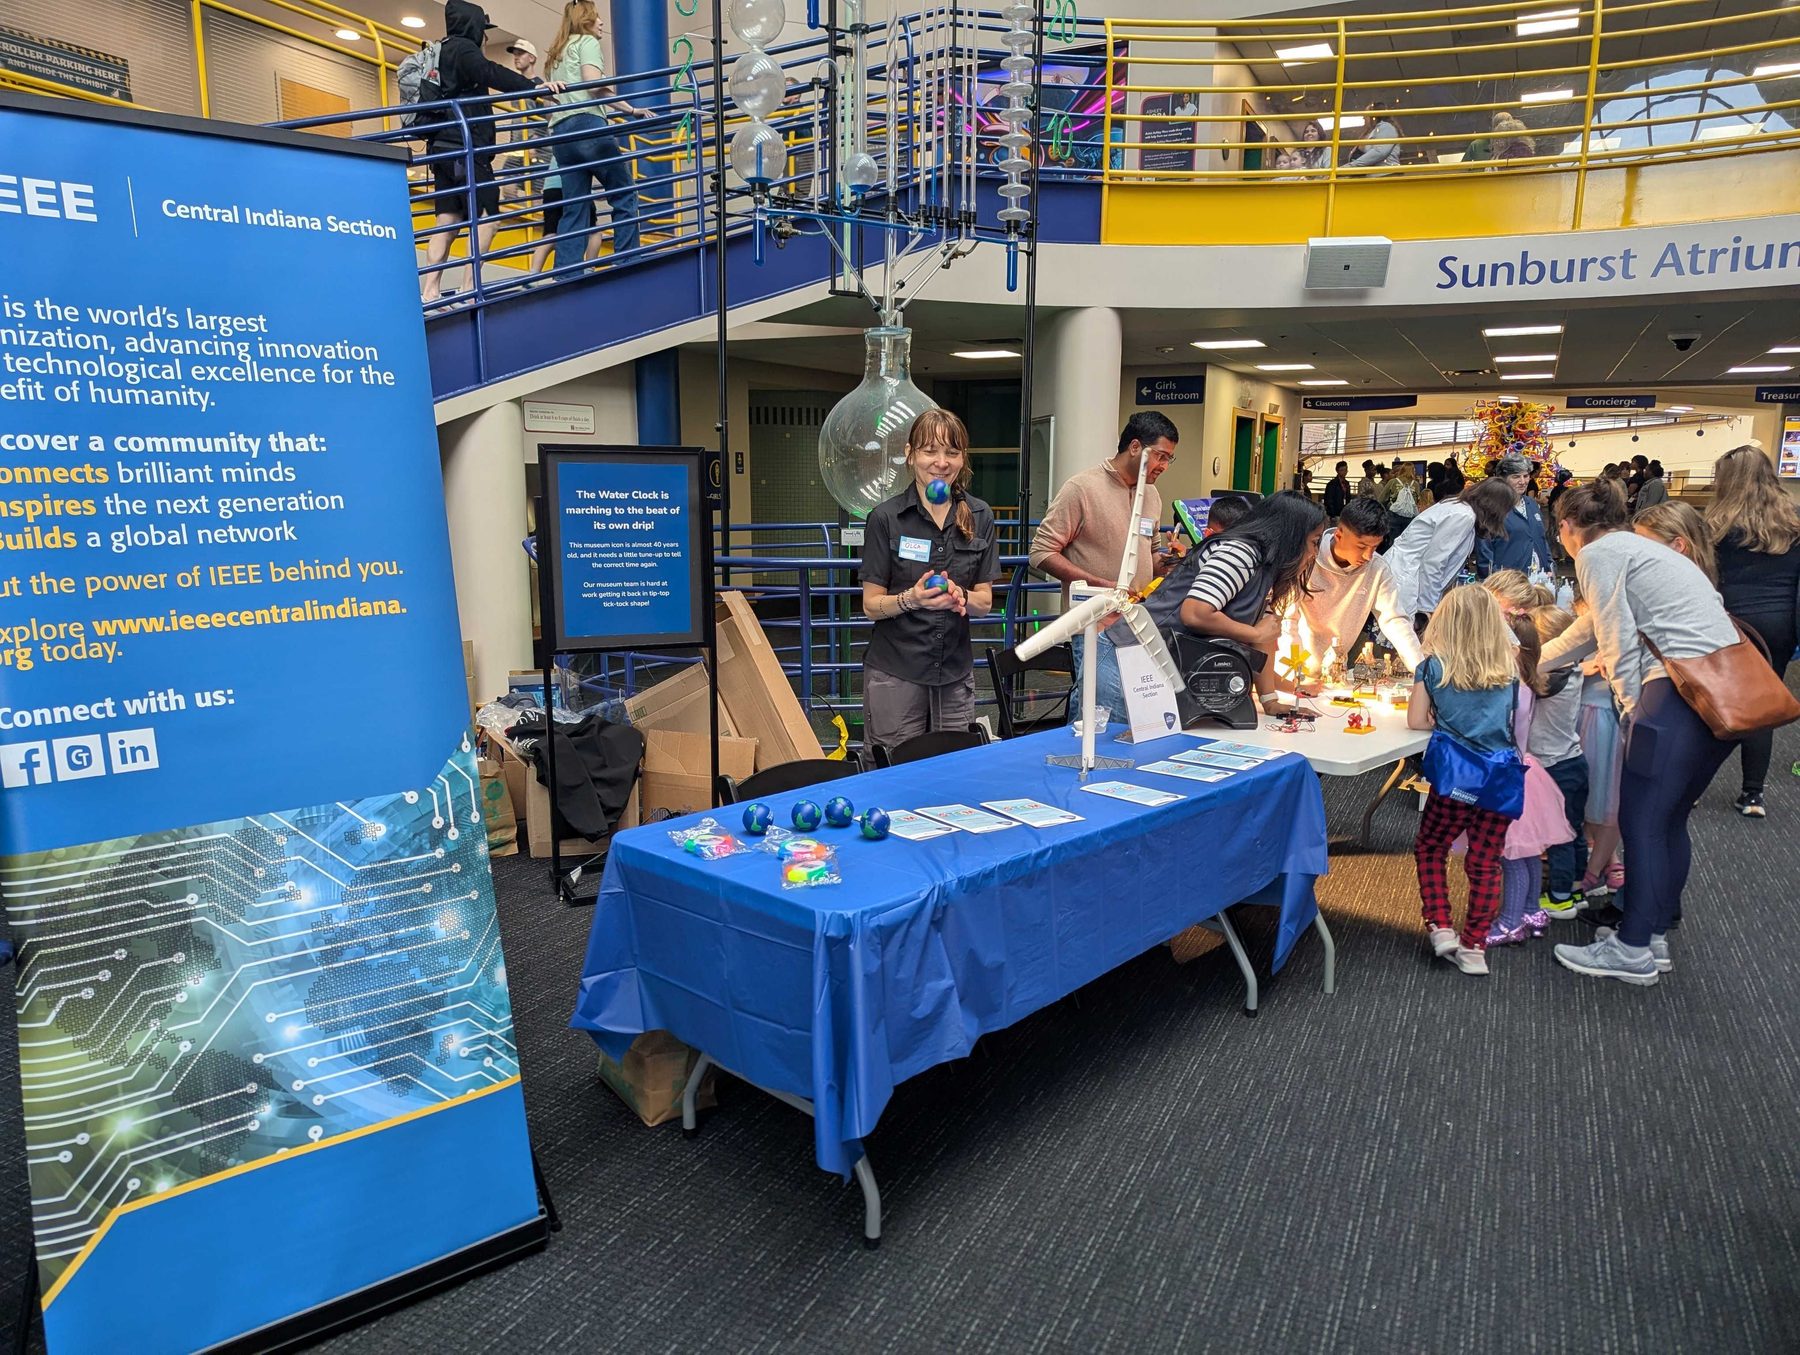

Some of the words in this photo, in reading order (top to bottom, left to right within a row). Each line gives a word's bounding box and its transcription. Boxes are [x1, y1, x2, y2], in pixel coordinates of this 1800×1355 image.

[0, 41, 43, 60] ROLLER
[46, 55, 93, 73] PARKING
[94, 67, 120, 82] HERE
[8, 58, 26, 68] AND
[28, 63, 56, 77] INSIDE
[59, 71, 74, 82] THE
[76, 75, 108, 90] EXHIBIT
[673, 36, 697, 94] 2
[162, 199, 239, 224] Central
[245, 207, 322, 231] Indiana
[327, 216, 397, 239] Section
[1436, 248, 1638, 290] Sunburst
[3, 295, 26, 318] is
[34, 297, 79, 322] the
[87, 304, 179, 329] world's
[186, 307, 268, 336] largest
[0, 323, 115, 355] nization,
[125, 331, 251, 362] advancing
[258, 337, 378, 361] innovation
[3, 351, 182, 385] technological
[191, 360, 316, 383] excellence
[323, 363, 353, 383] for
[360, 364, 395, 386] the
[0, 378, 46, 401] efit
[54, 380, 80, 402] of
[89, 380, 216, 412] humanity.
[1155, 381, 1176, 390] Girls
[1155, 391, 1199, 401] Restroom
[1585, 397, 1637, 409] Concierge
[0, 433, 79, 452] cover
[89, 435, 105, 451] a
[114, 432, 261, 458] community
[268, 432, 327, 452] that:
[0, 464, 109, 484] onnects
[117, 461, 214, 484] brilliant
[222, 461, 296, 482] minds
[104, 493, 147, 515] the
[156, 495, 210, 514] next
[218, 490, 345, 519] generation
[576, 490, 596, 499] The
[598, 490, 629, 499] Water
[631, 490, 659, 499] Clock
[660, 490, 670, 499] is
[565, 506, 612, 516] marching
[614, 507, 625, 515] to
[627, 506, 644, 515] the
[645, 506, 668, 515] beat
[670, 506, 680, 515] of
[593, 521, 606, 530] its
[632, 521, 655, 531] drip!
[0, 525, 77, 550] uilds
[87, 531, 101, 547] a
[111, 523, 188, 553] global
[197, 520, 298, 544] network
[569, 541, 583, 549] This
[611, 541, 624, 549] icon
[29, 571, 76, 595] the
[85, 572, 168, 598] power
[176, 566, 201, 587] of
[209, 563, 263, 586] IEEE
[269, 557, 351, 583] behind
[357, 561, 404, 583] you.
[598, 591, 620, 599] getting
[92, 597, 407, 637] www.ieeecentralindiana.
[0, 647, 34, 671] rg
[40, 637, 123, 664] today.
[1133, 685, 1149, 693] Central
[1149, 683, 1165, 691] Indiana
[1141, 674, 1154, 683] IEEE
[0, 697, 116, 729] Connect
[123, 688, 186, 716] with
[195, 688, 235, 707] us:
[1142, 691, 1158, 699] Section
